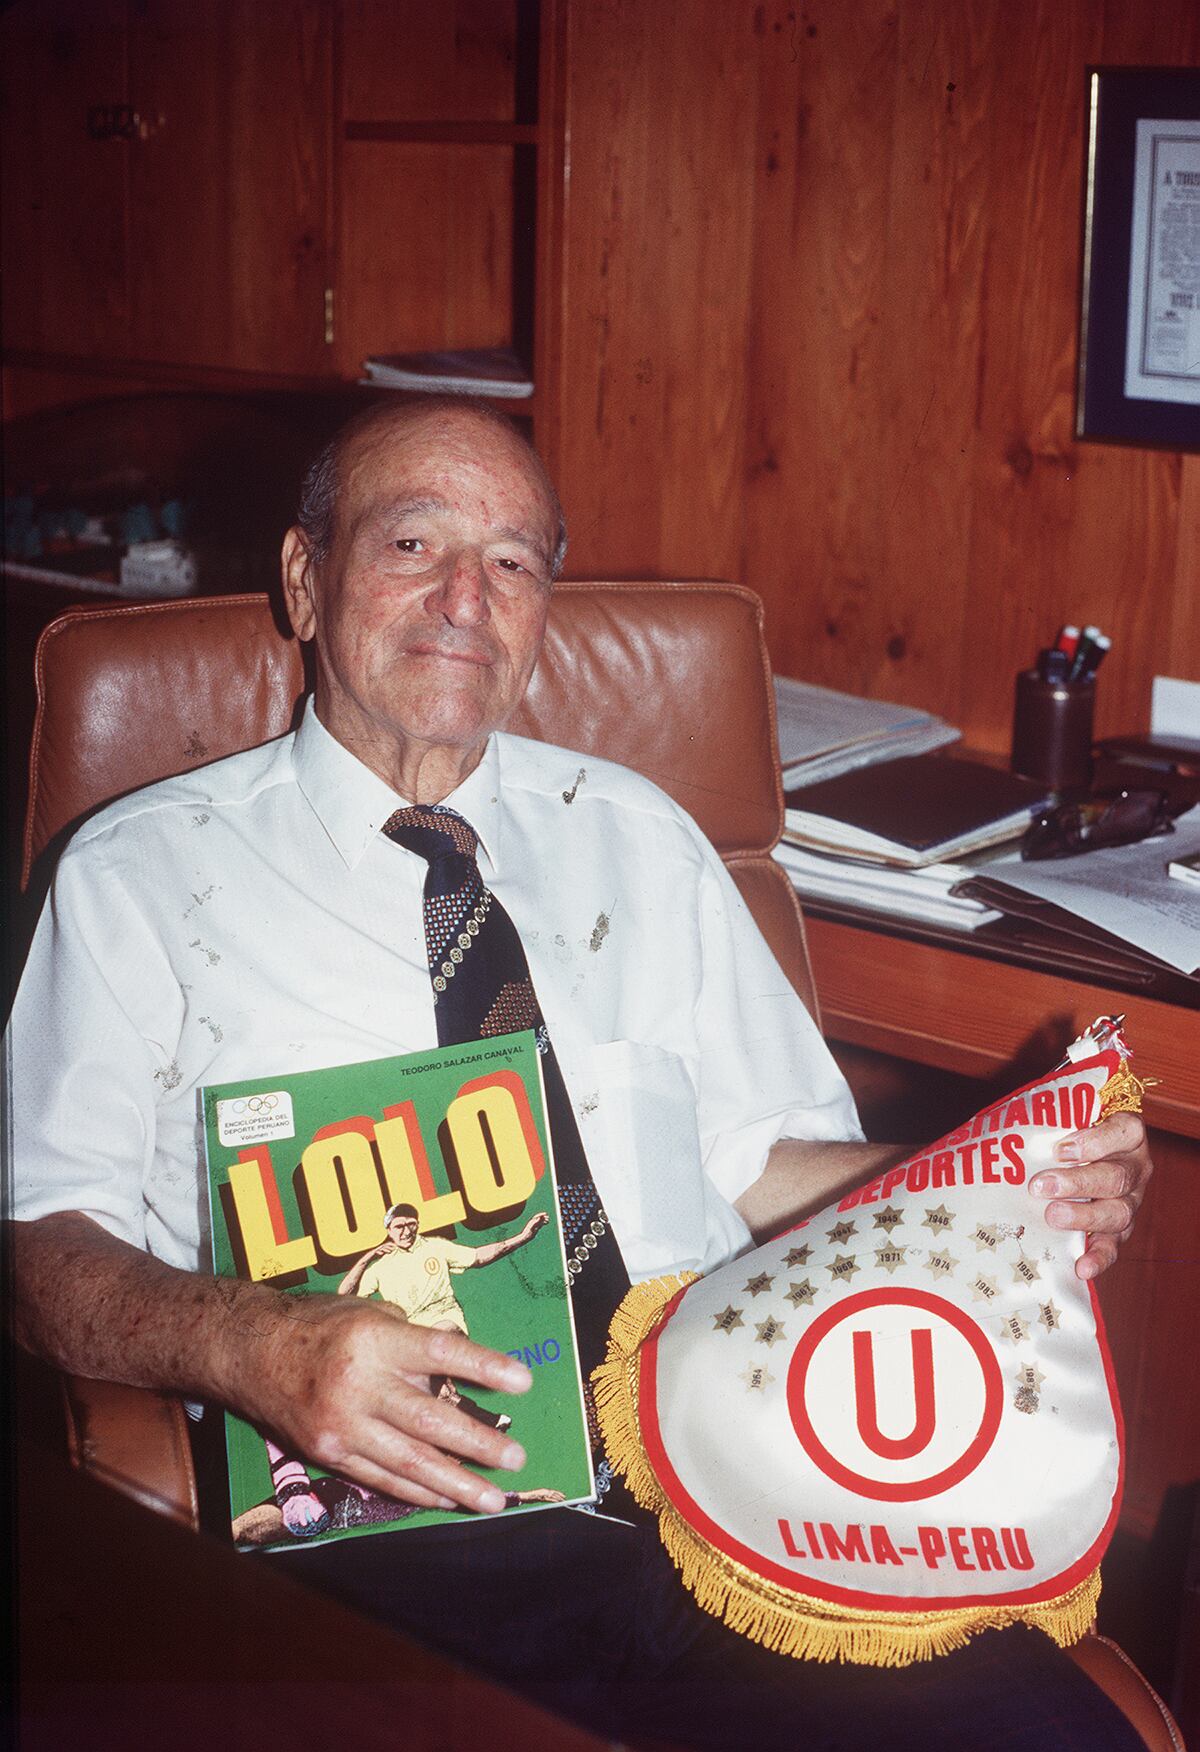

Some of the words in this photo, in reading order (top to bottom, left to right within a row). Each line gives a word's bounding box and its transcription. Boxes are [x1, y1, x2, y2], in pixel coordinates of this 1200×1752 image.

[400, 1062, 442, 1076] TEODORO
[443, 1055, 483, 1069] SALAZAR
[484, 1046, 524, 1061] CANAVAL
[224, 1126, 256, 1136] DEPORTE
[257, 1120, 290, 1131] PERUANO
[225, 1116, 273, 1128] ENCICLOPEDIA
[275, 1113, 288, 1121] DEL
[241, 1132, 269, 1141] Volumen
[837, 1133, 1026, 1213] DEPORTES
[228, 1086, 536, 1283] LOLO
[878, 1215, 898, 1224] 1945
[927, 1214, 949, 1226] 1946
[976, 1229, 996, 1247] 1949
[880, 1253, 901, 1262] 1971
[931, 1257, 950, 1271] 1974
[832, 1260, 856, 1275] 1969
[1016, 1261, 1034, 1281] 1959
[792, 1284, 812, 1301] 1967
[974, 1279, 995, 1299] 1982
[1009, 1317, 1024, 1340] 1985
[751, 1368, 763, 1389] 1964
[852, 1329, 936, 1460] U
[777, 1519, 1035, 1572] LIMA-PERU
